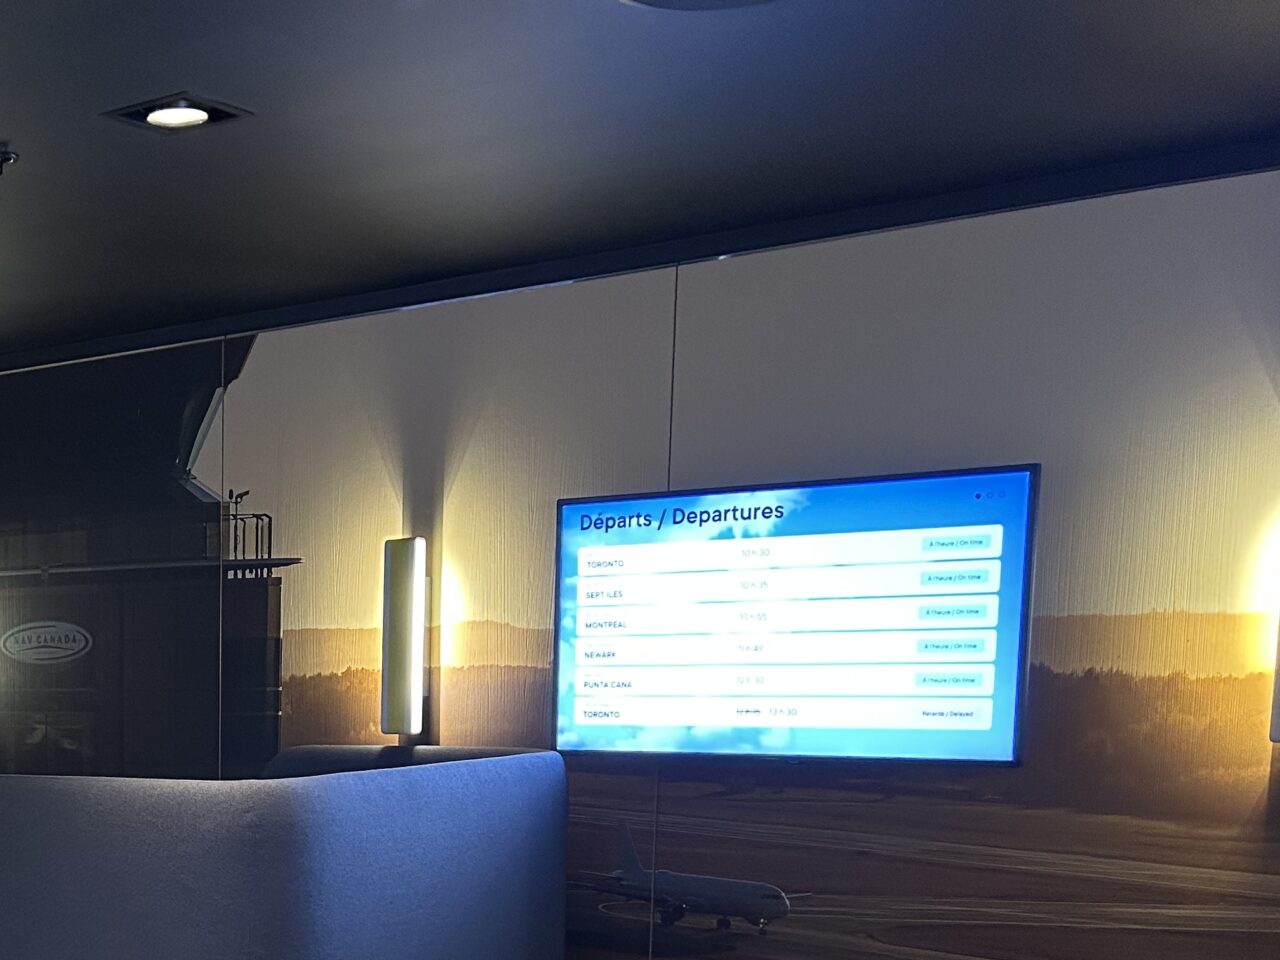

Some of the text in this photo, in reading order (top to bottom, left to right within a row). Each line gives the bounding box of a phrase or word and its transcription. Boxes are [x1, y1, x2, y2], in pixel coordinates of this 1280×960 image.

[580, 512, 652, 533] Départs
[672, 505, 784, 527] Departures
[587, 560, 624, 568] TORONTO
[36, 633, 77, 644] CANADA
